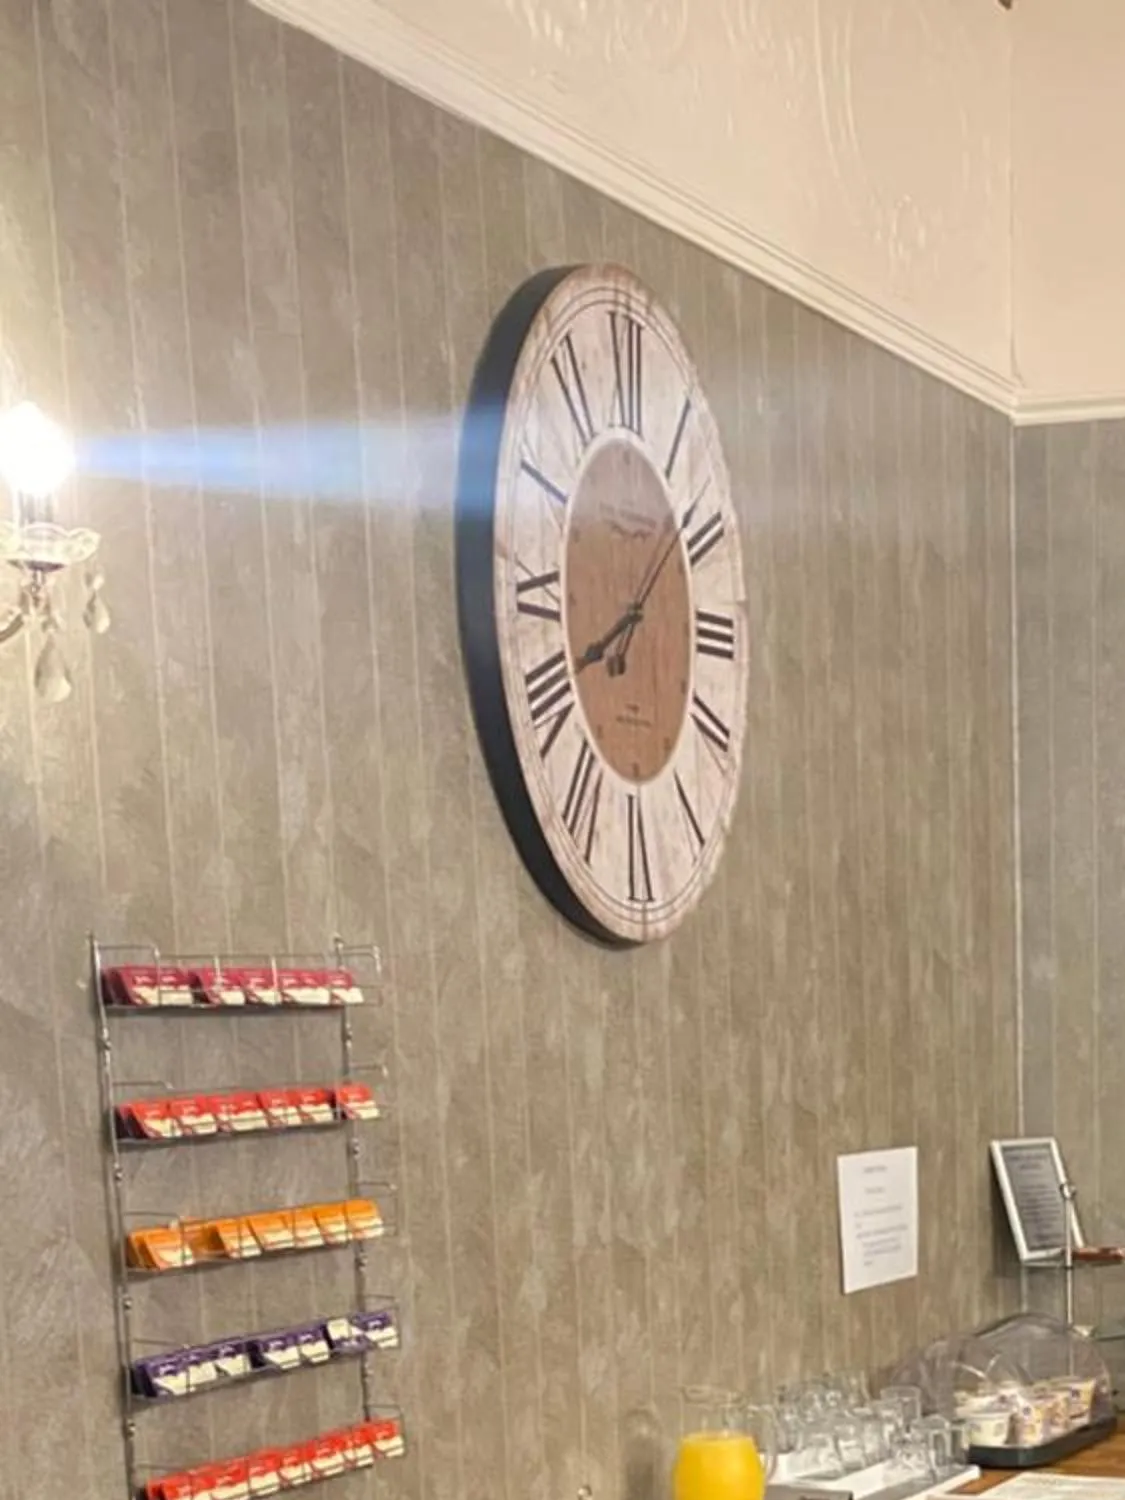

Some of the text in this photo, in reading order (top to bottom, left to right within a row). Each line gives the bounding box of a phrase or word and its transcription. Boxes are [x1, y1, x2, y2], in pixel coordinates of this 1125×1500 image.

[550, 328, 598, 462] XI
[607, 311, 644, 437] XII
[665, 393, 694, 479] I
[514, 550, 562, 623] IX
[686, 511, 725, 567] II
[695, 611, 735, 660] III
[524, 651, 575, 760] VIII
[561, 738, 604, 868] VII
[627, 793, 656, 902] VI
[672, 769, 706, 868] V
